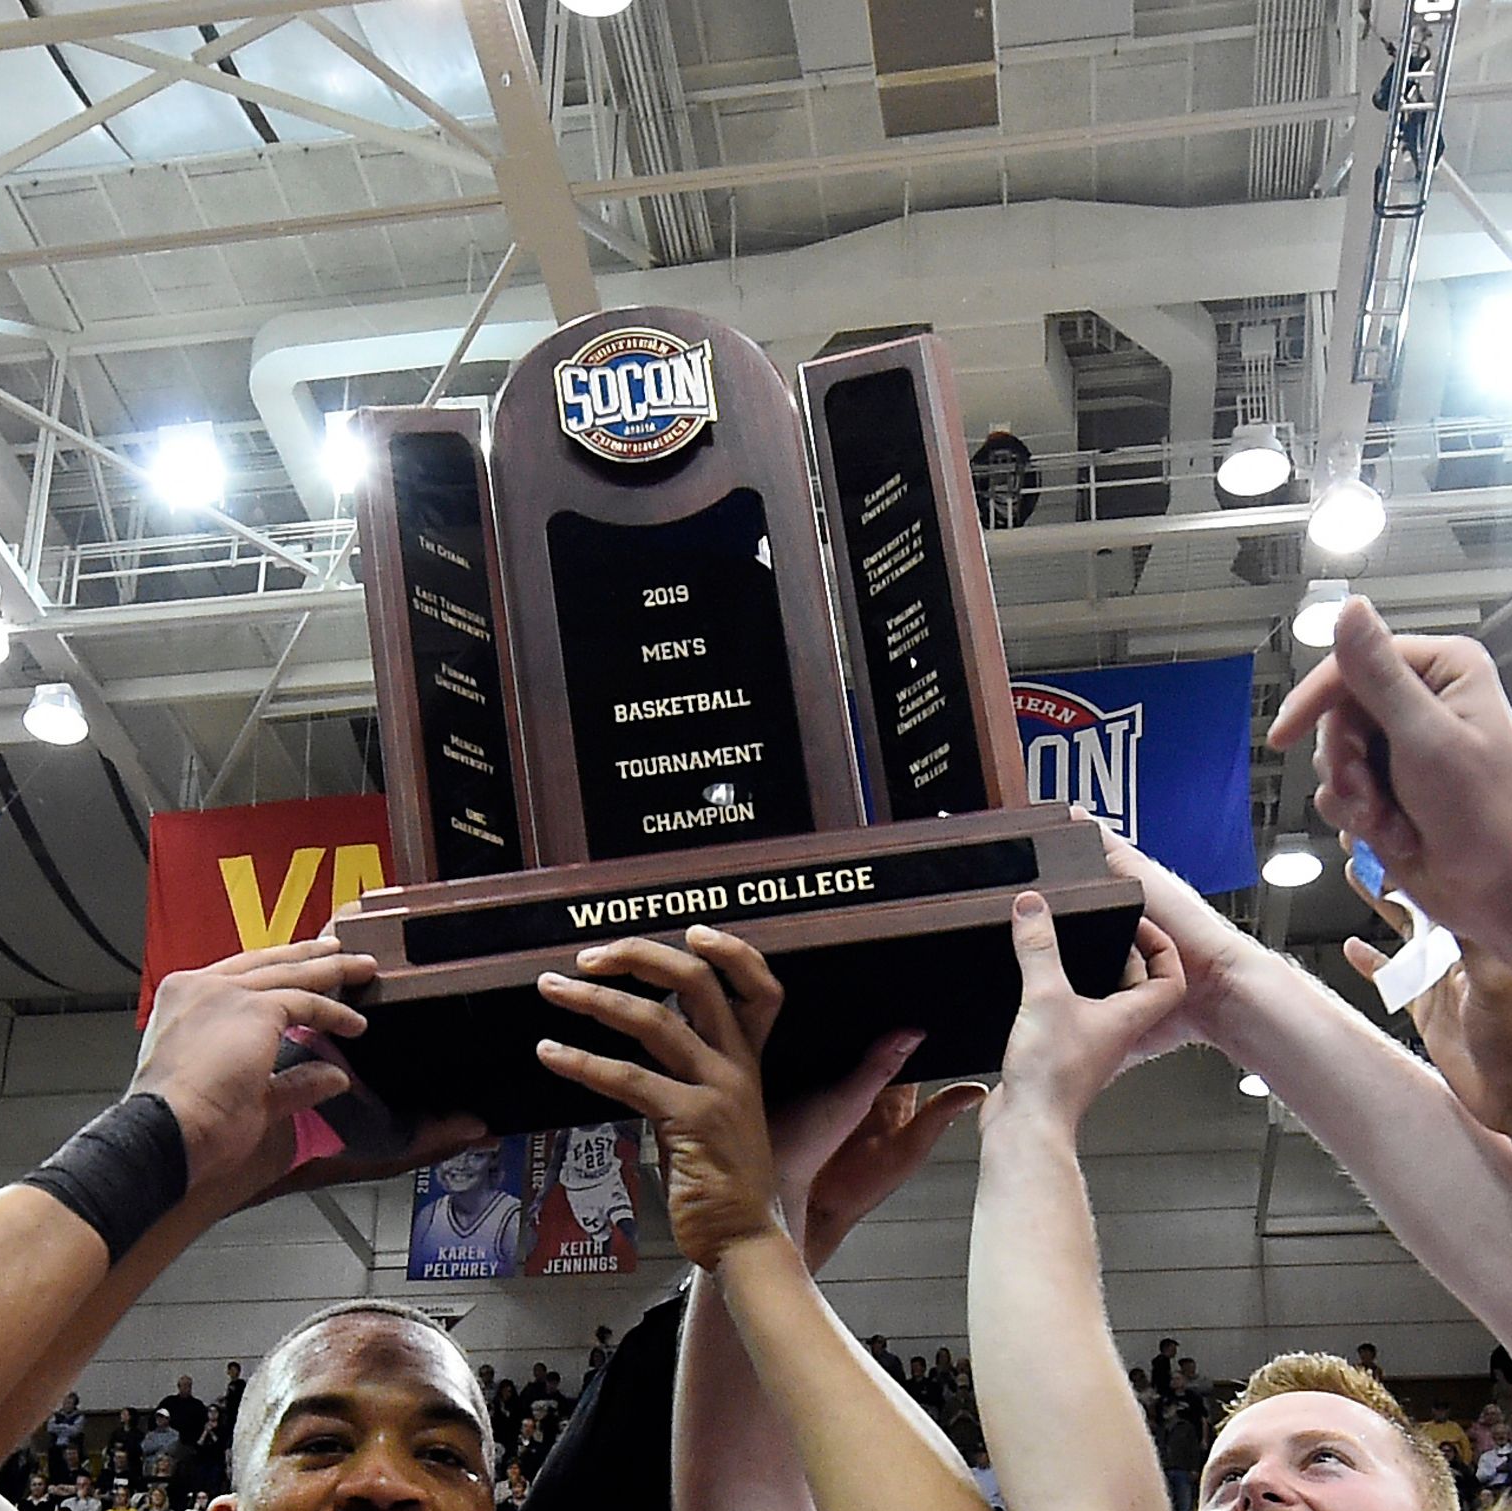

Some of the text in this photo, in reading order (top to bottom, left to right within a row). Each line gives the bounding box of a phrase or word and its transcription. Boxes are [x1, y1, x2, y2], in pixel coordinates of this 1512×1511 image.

[642, 585, 689, 608] 2019
[641, 637, 707, 663] MEN'S
[614, 688, 751, 723] BASKETBALL
[615, 743, 764, 779] TOURNAMENT
[642, 801, 755, 834] CHAMPION
[567, 866, 875, 929] WOFFORD COLLEGE
[585, 1152, 605, 1169] 22
[438, 1246, 486, 1260] KAREN
[560, 1240, 604, 1257] KEITH
[424, 1261, 499, 1277] PELPHREY
[543, 1256, 618, 1274] JENNINGS
